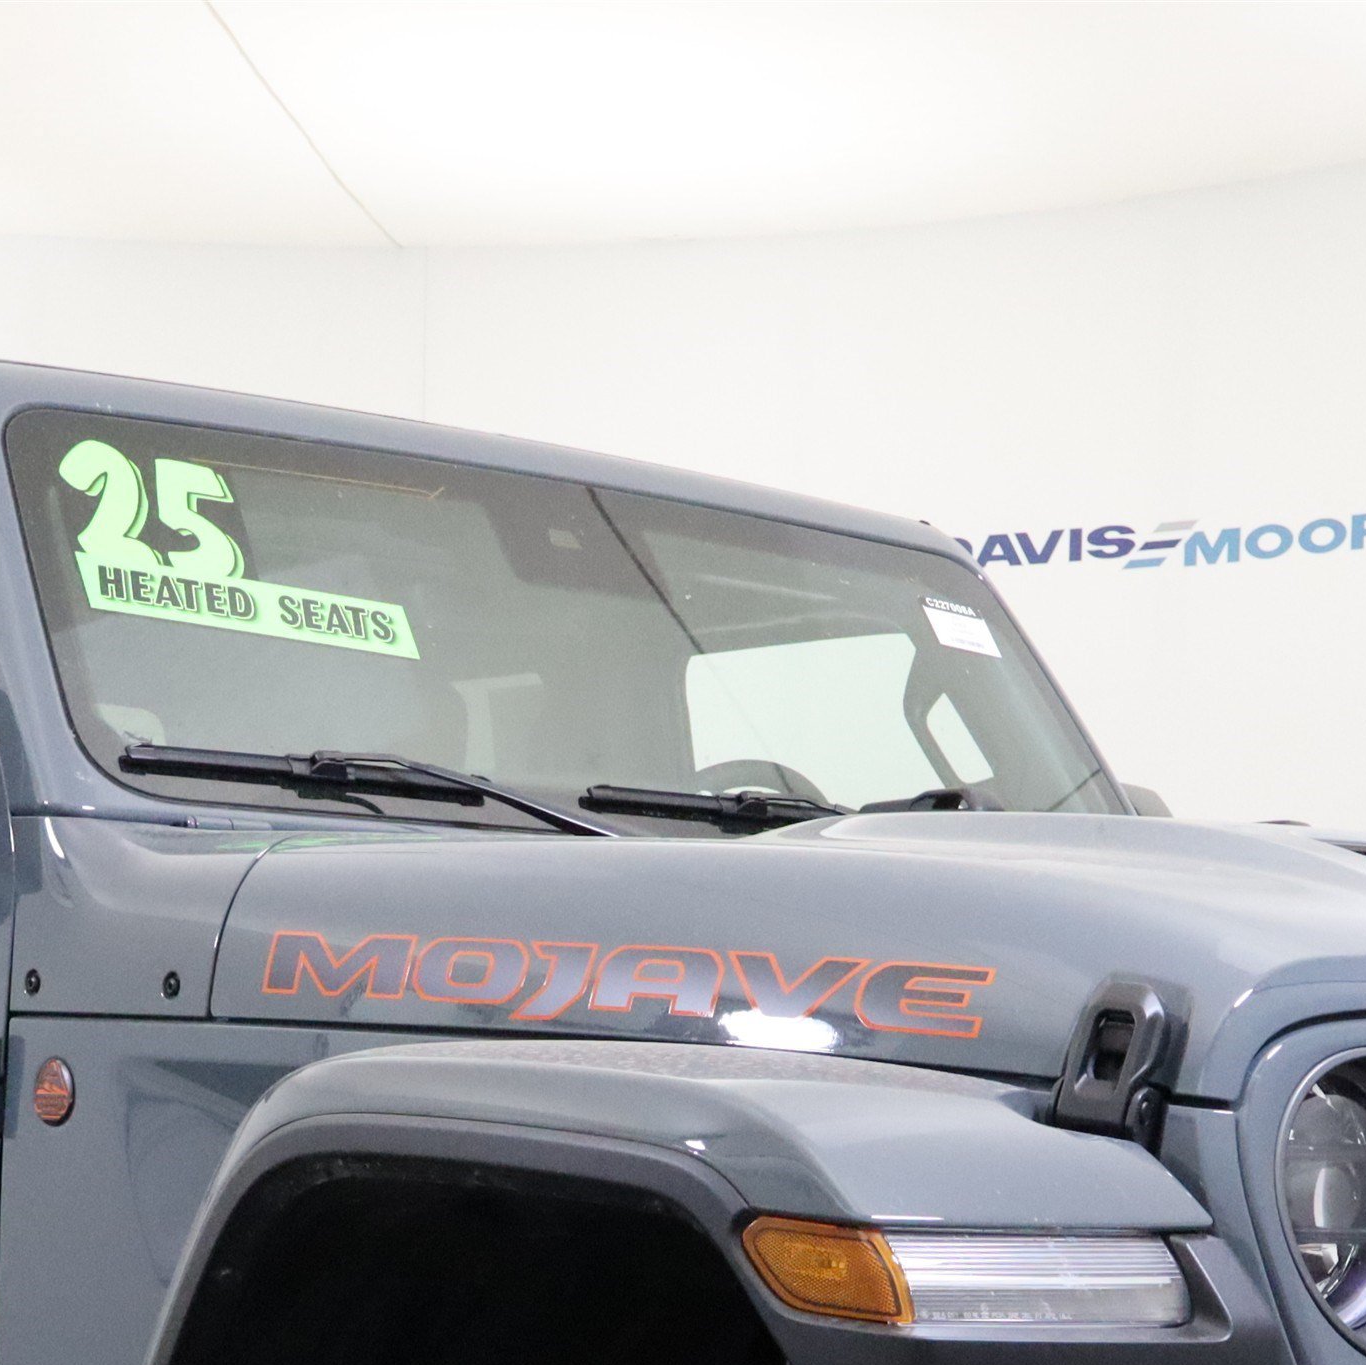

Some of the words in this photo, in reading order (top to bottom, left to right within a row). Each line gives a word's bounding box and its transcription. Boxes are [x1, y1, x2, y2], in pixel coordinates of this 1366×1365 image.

[59, 440, 244, 578] 25
[954, 525, 1135, 567] AVIS
[98, 565, 255, 619] HEATED
[277, 595, 394, 643] SEATS
[261, 931, 997, 1038] MOJAVE
